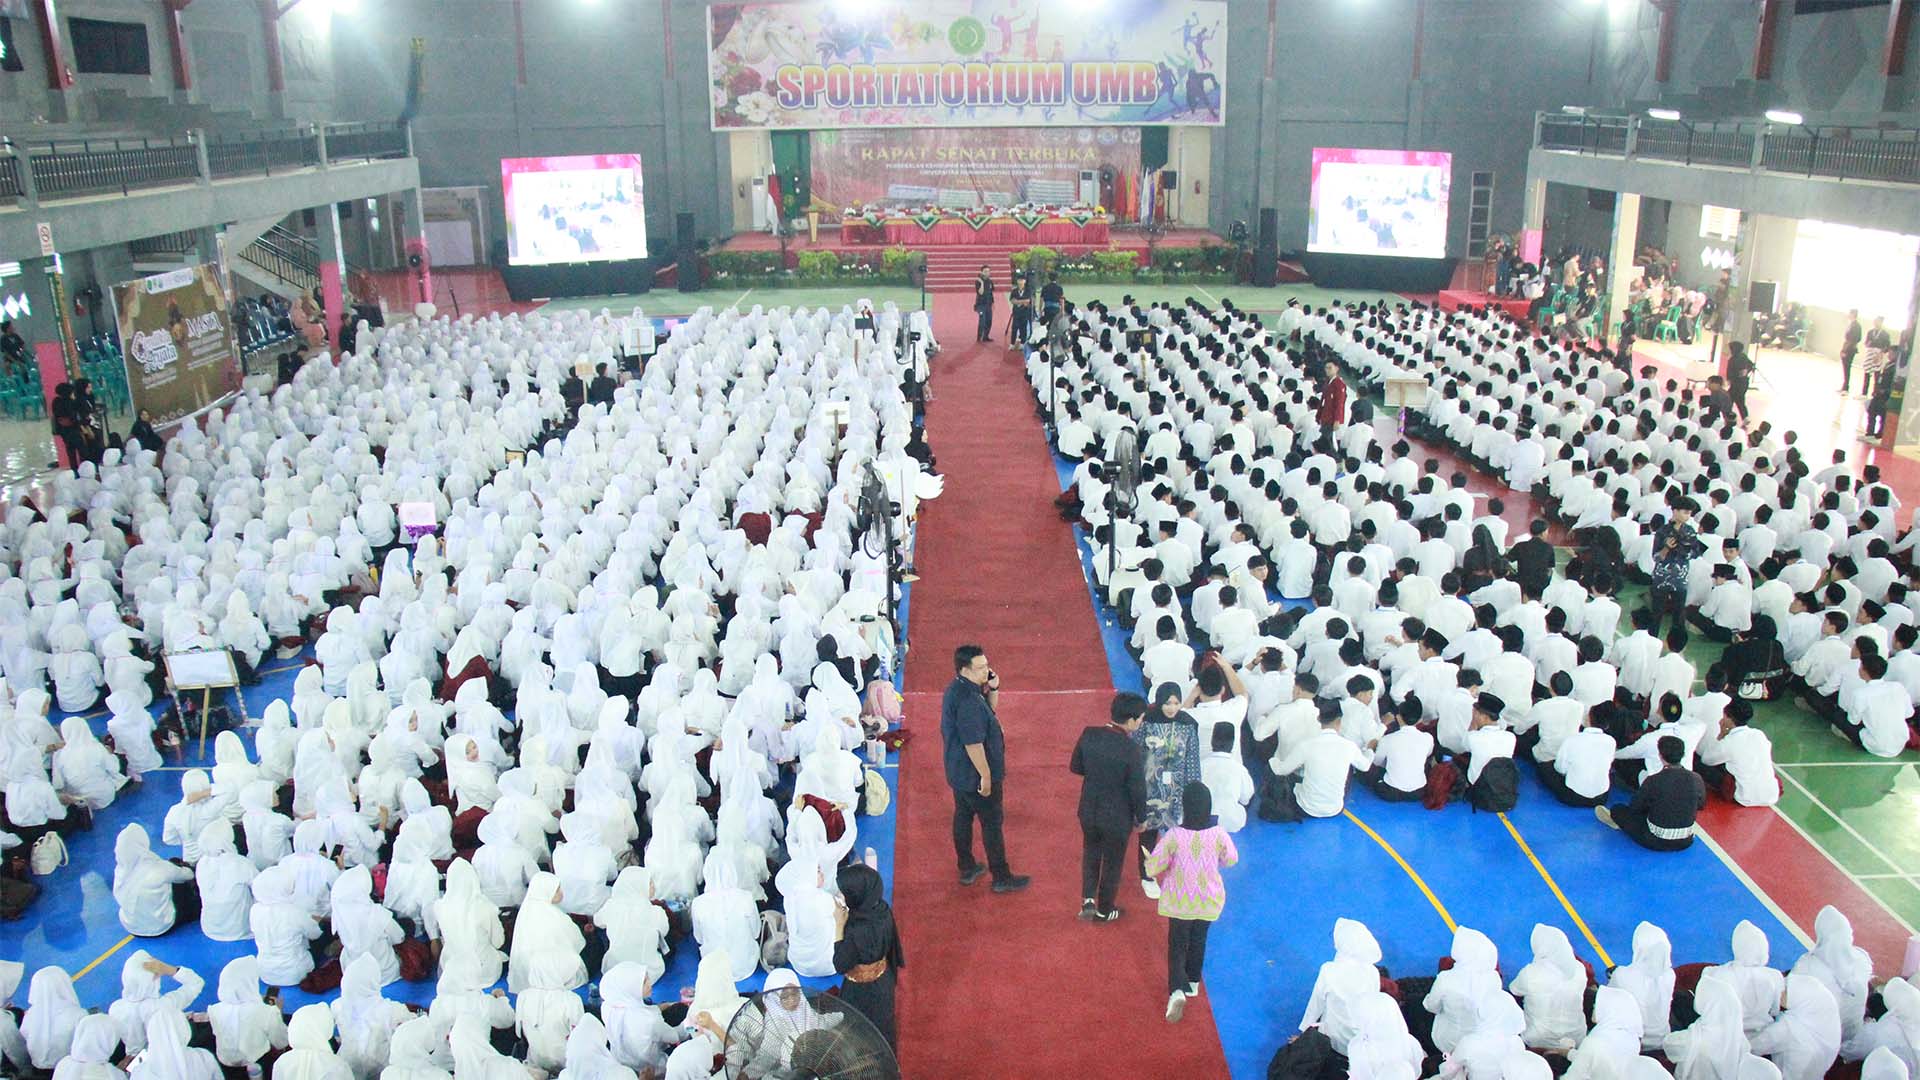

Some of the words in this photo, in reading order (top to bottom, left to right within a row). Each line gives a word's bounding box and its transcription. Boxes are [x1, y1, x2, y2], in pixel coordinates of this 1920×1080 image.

[776, 62, 1064, 109] SPORTATORIUM
[1071, 61, 1158, 106] UMB
[862, 147, 926, 160] RAPAT
[935, 147, 998, 160] SENAT
[1007, 147, 1097, 160] TERBUKA
